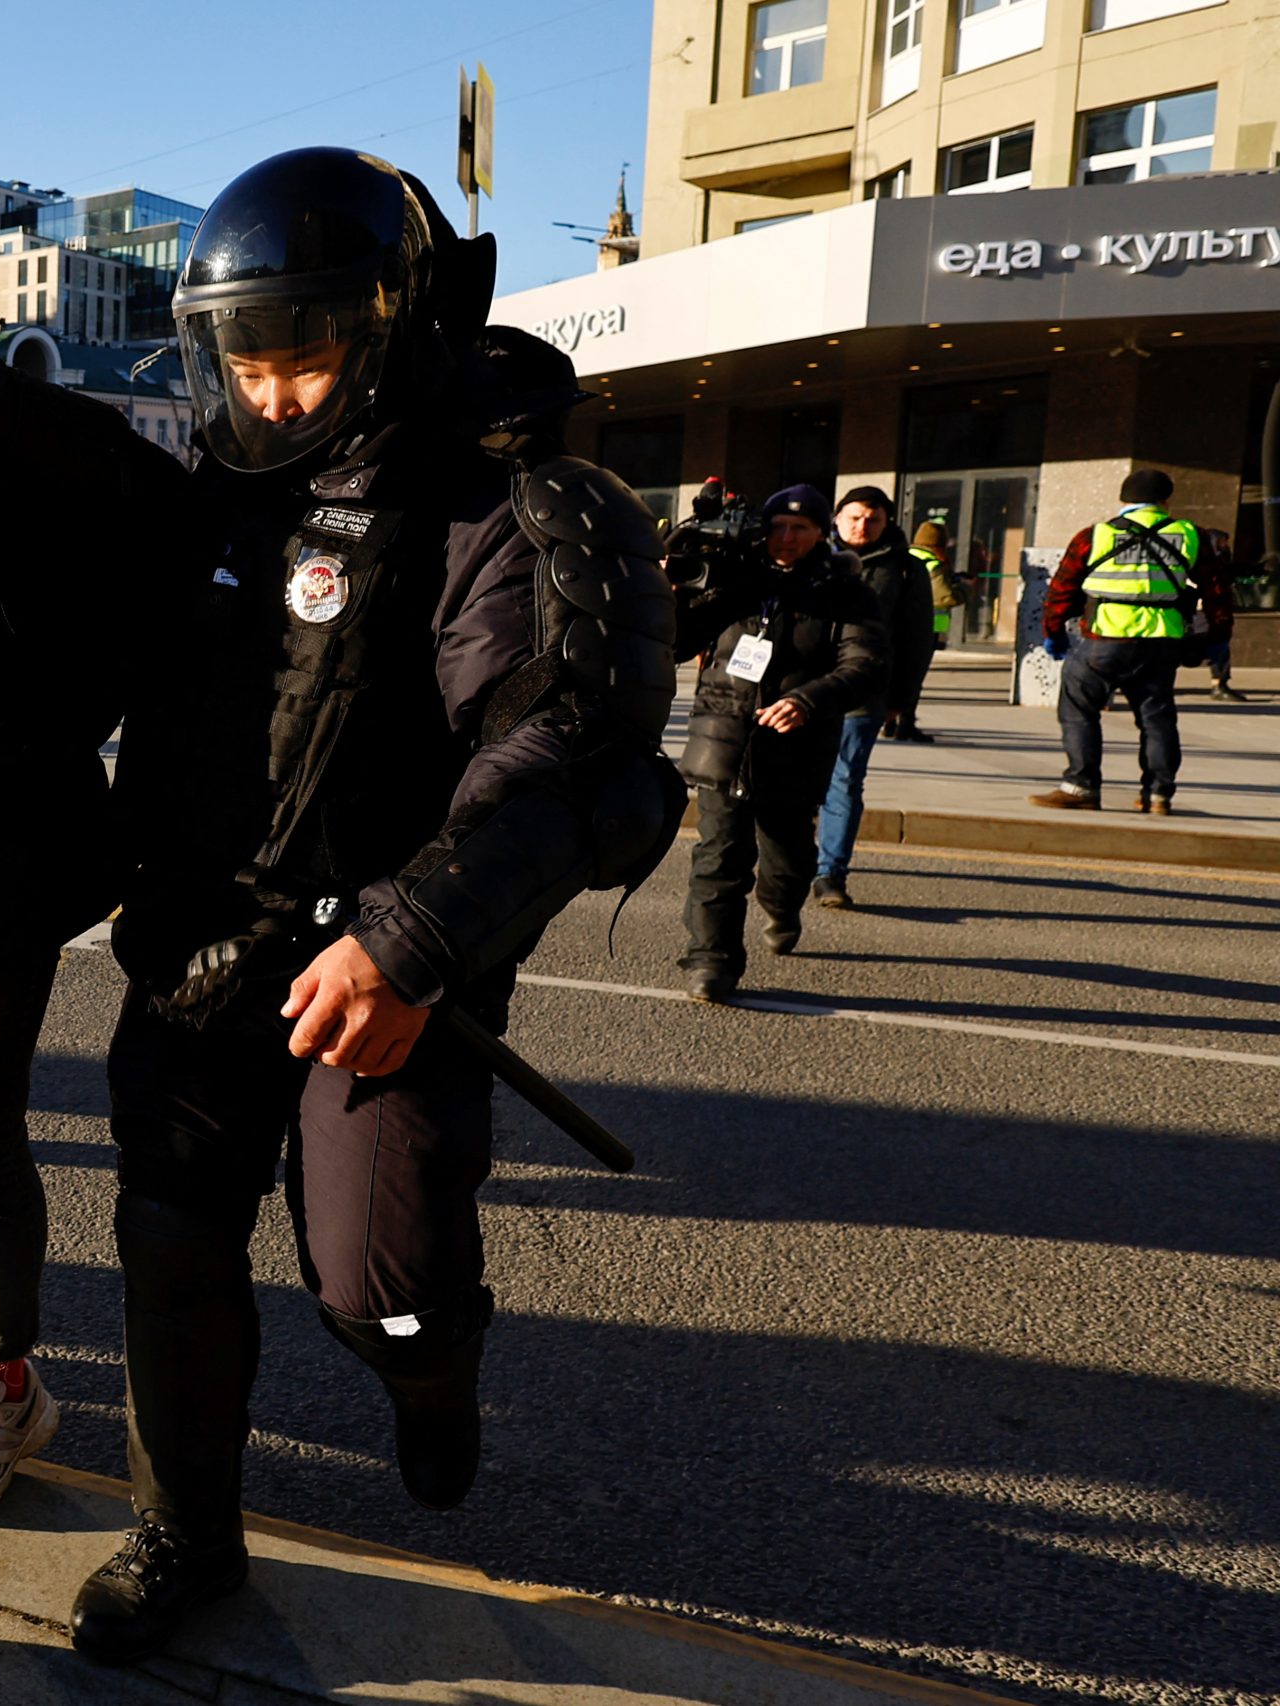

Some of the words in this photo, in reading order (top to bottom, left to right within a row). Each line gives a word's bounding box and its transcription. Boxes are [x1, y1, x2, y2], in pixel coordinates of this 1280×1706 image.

[938, 239, 1043, 278] еда
[311, 510, 324, 522] 2
[322, 518, 347, 529] ПОЛК
